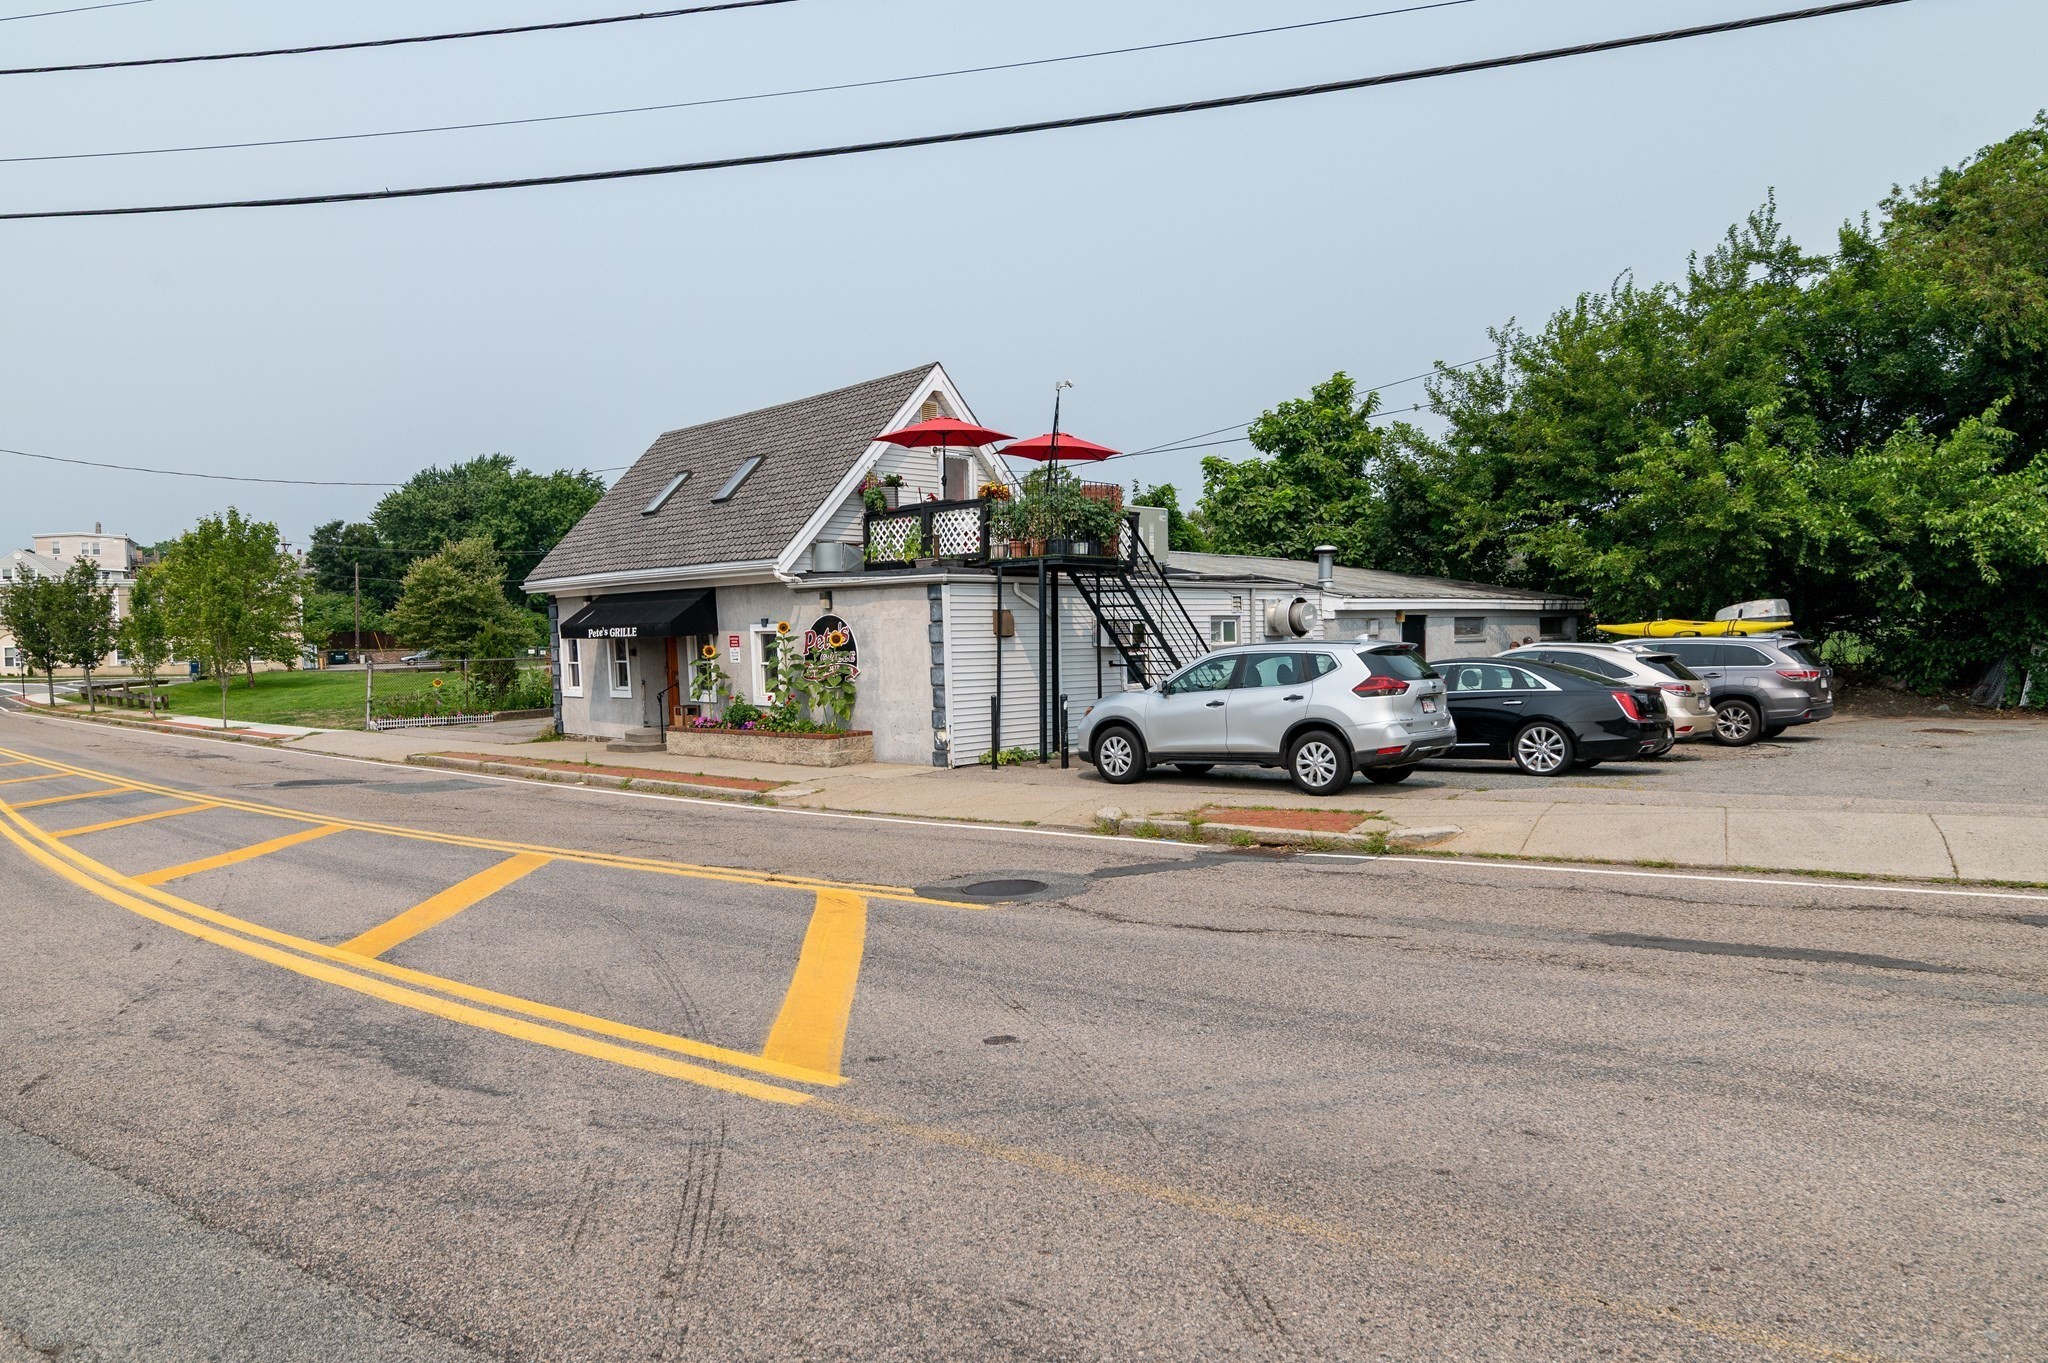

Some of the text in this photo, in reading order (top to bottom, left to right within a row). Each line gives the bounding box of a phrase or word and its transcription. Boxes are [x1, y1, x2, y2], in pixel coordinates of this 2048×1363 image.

[588, 627, 637, 638] Pete's GRILLE
[803, 621, 850, 656] Pet's
